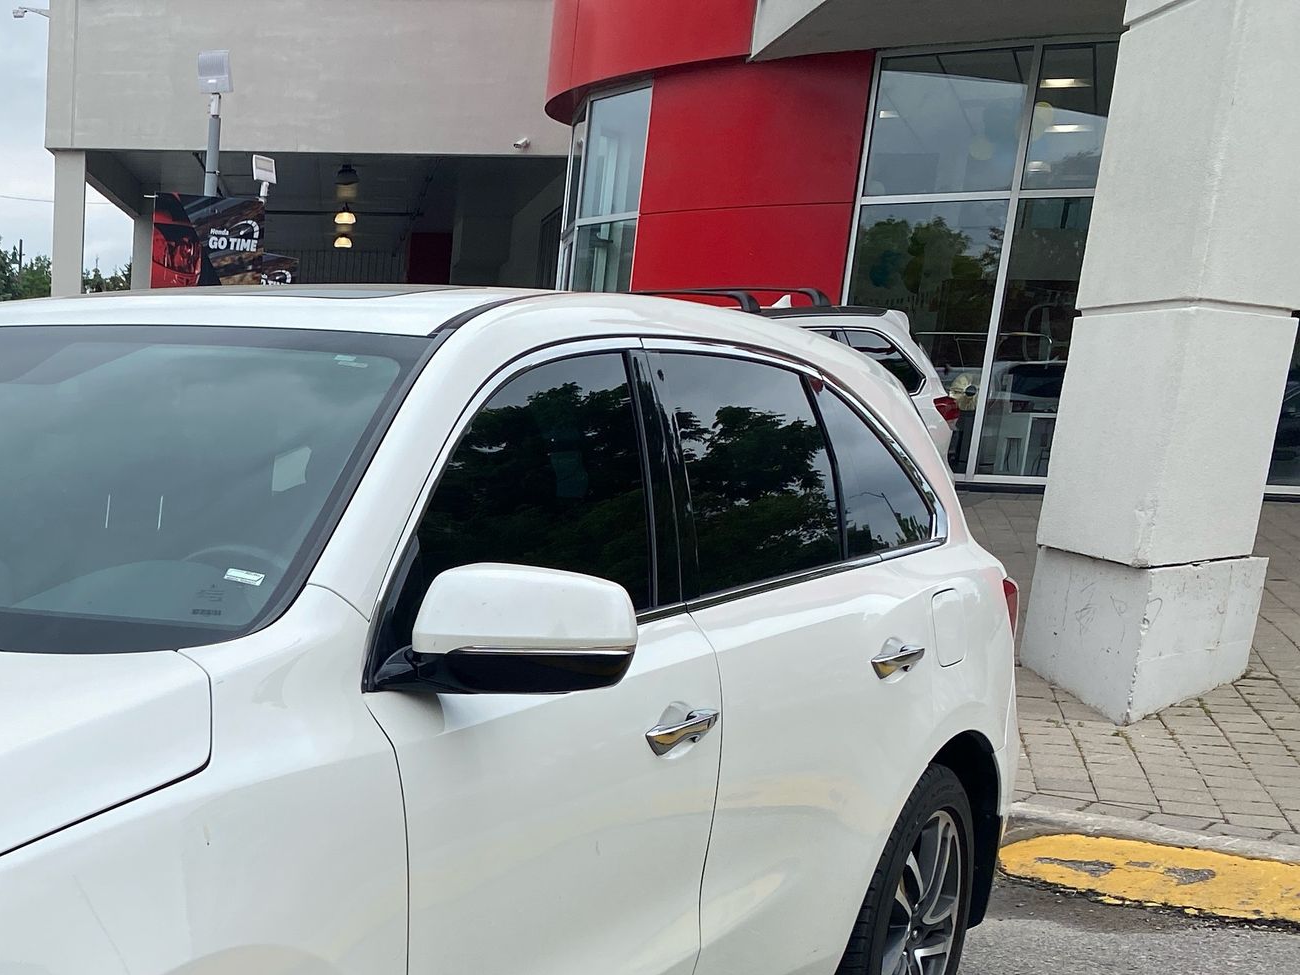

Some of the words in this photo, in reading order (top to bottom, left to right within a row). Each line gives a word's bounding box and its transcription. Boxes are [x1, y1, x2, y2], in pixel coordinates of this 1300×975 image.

[210, 228, 229, 236] Honda
[208, 236, 228, 250] GO
[229, 237, 258, 252] TIME
